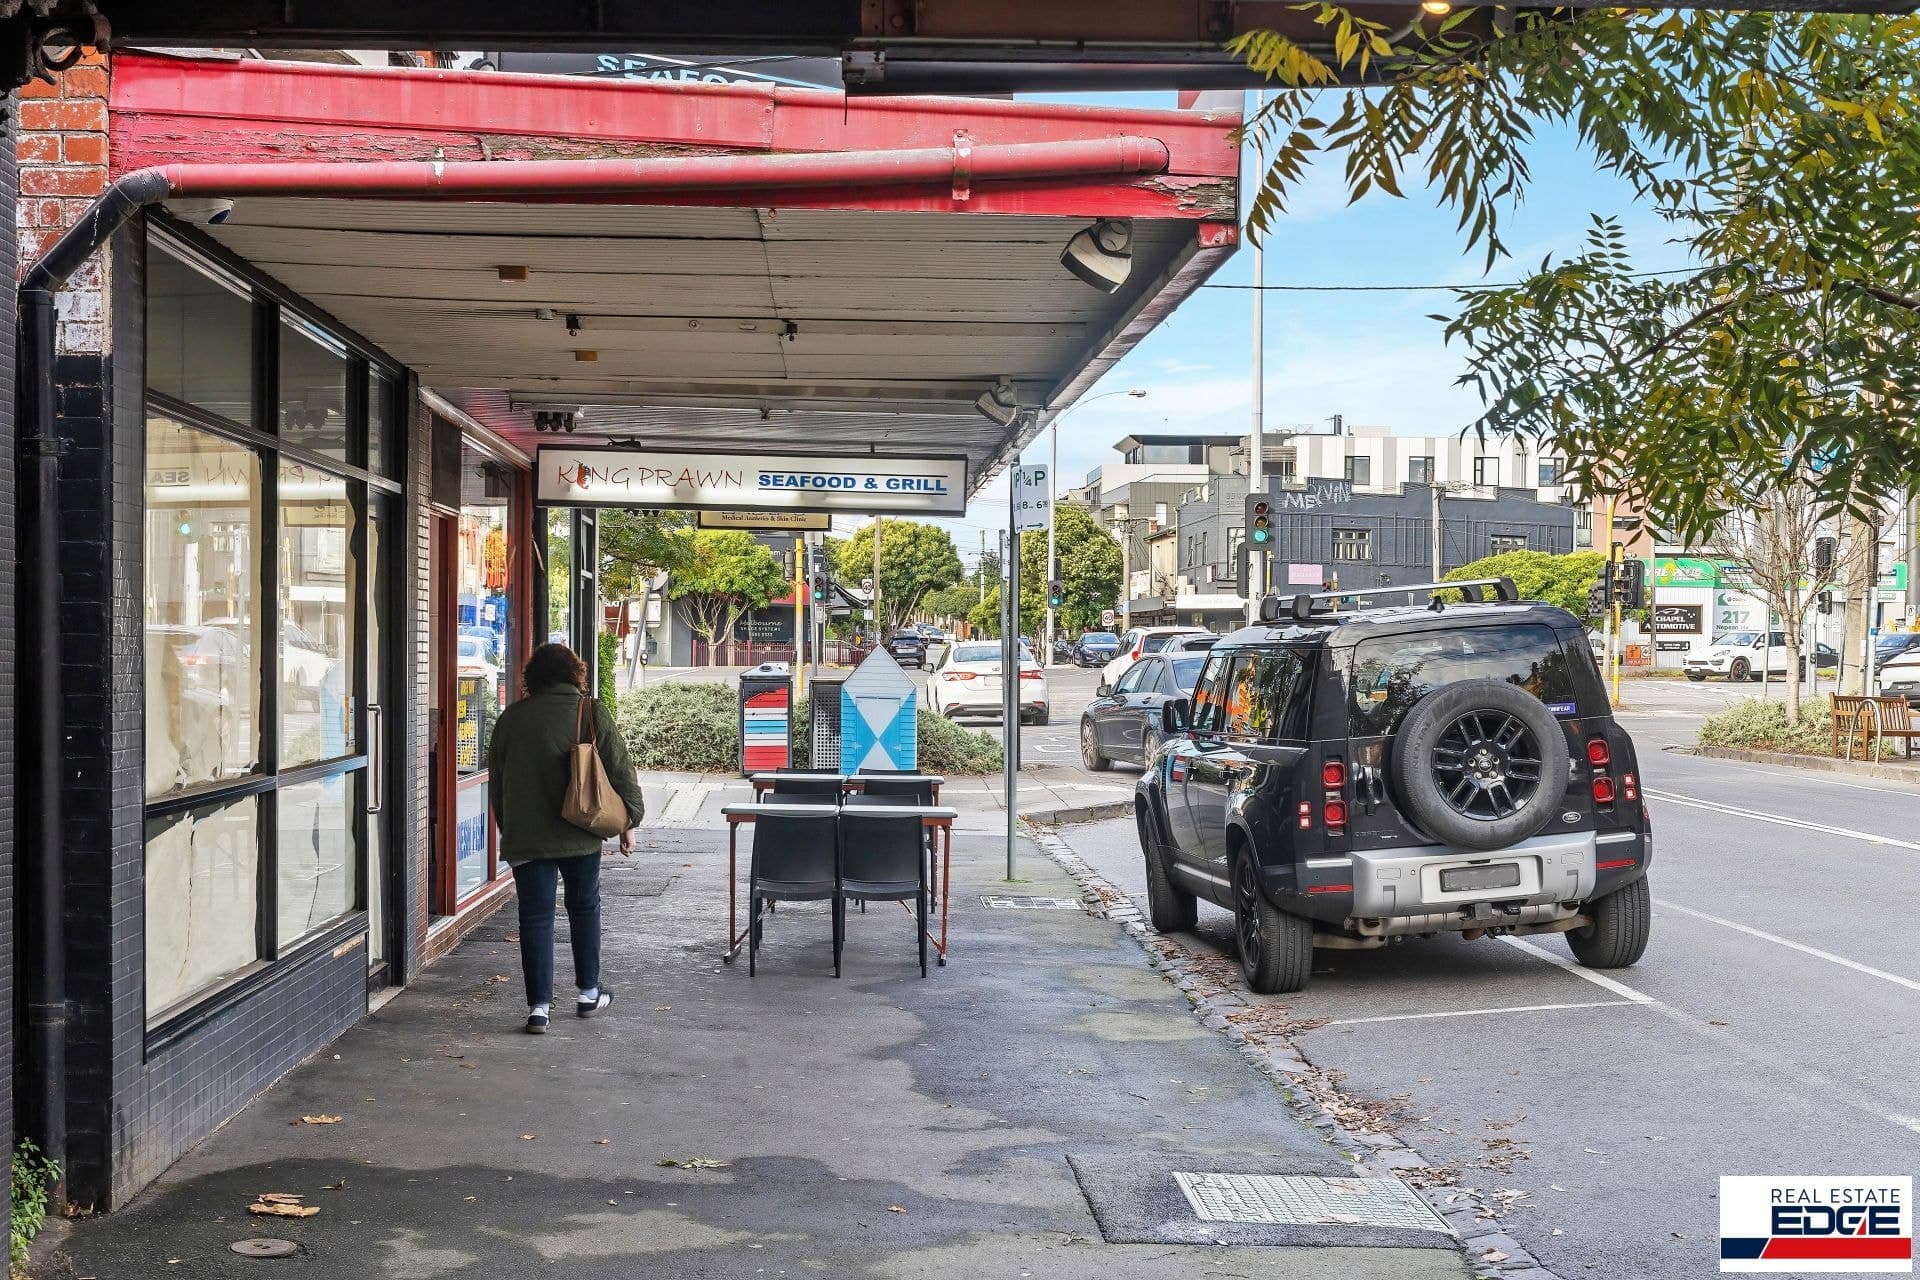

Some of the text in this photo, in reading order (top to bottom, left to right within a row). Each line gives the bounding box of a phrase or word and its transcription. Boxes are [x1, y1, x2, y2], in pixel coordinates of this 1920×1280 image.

[639, 467, 743, 489] PRAWN
[759, 474, 856, 489] SEAFOOD
[864, 477, 878, 490] &
[886, 478, 948, 491] GRILL
[721, 513, 744, 521] Medical
[790, 515, 807, 523] Clinic
[1722, 610, 1751, 624] 217
